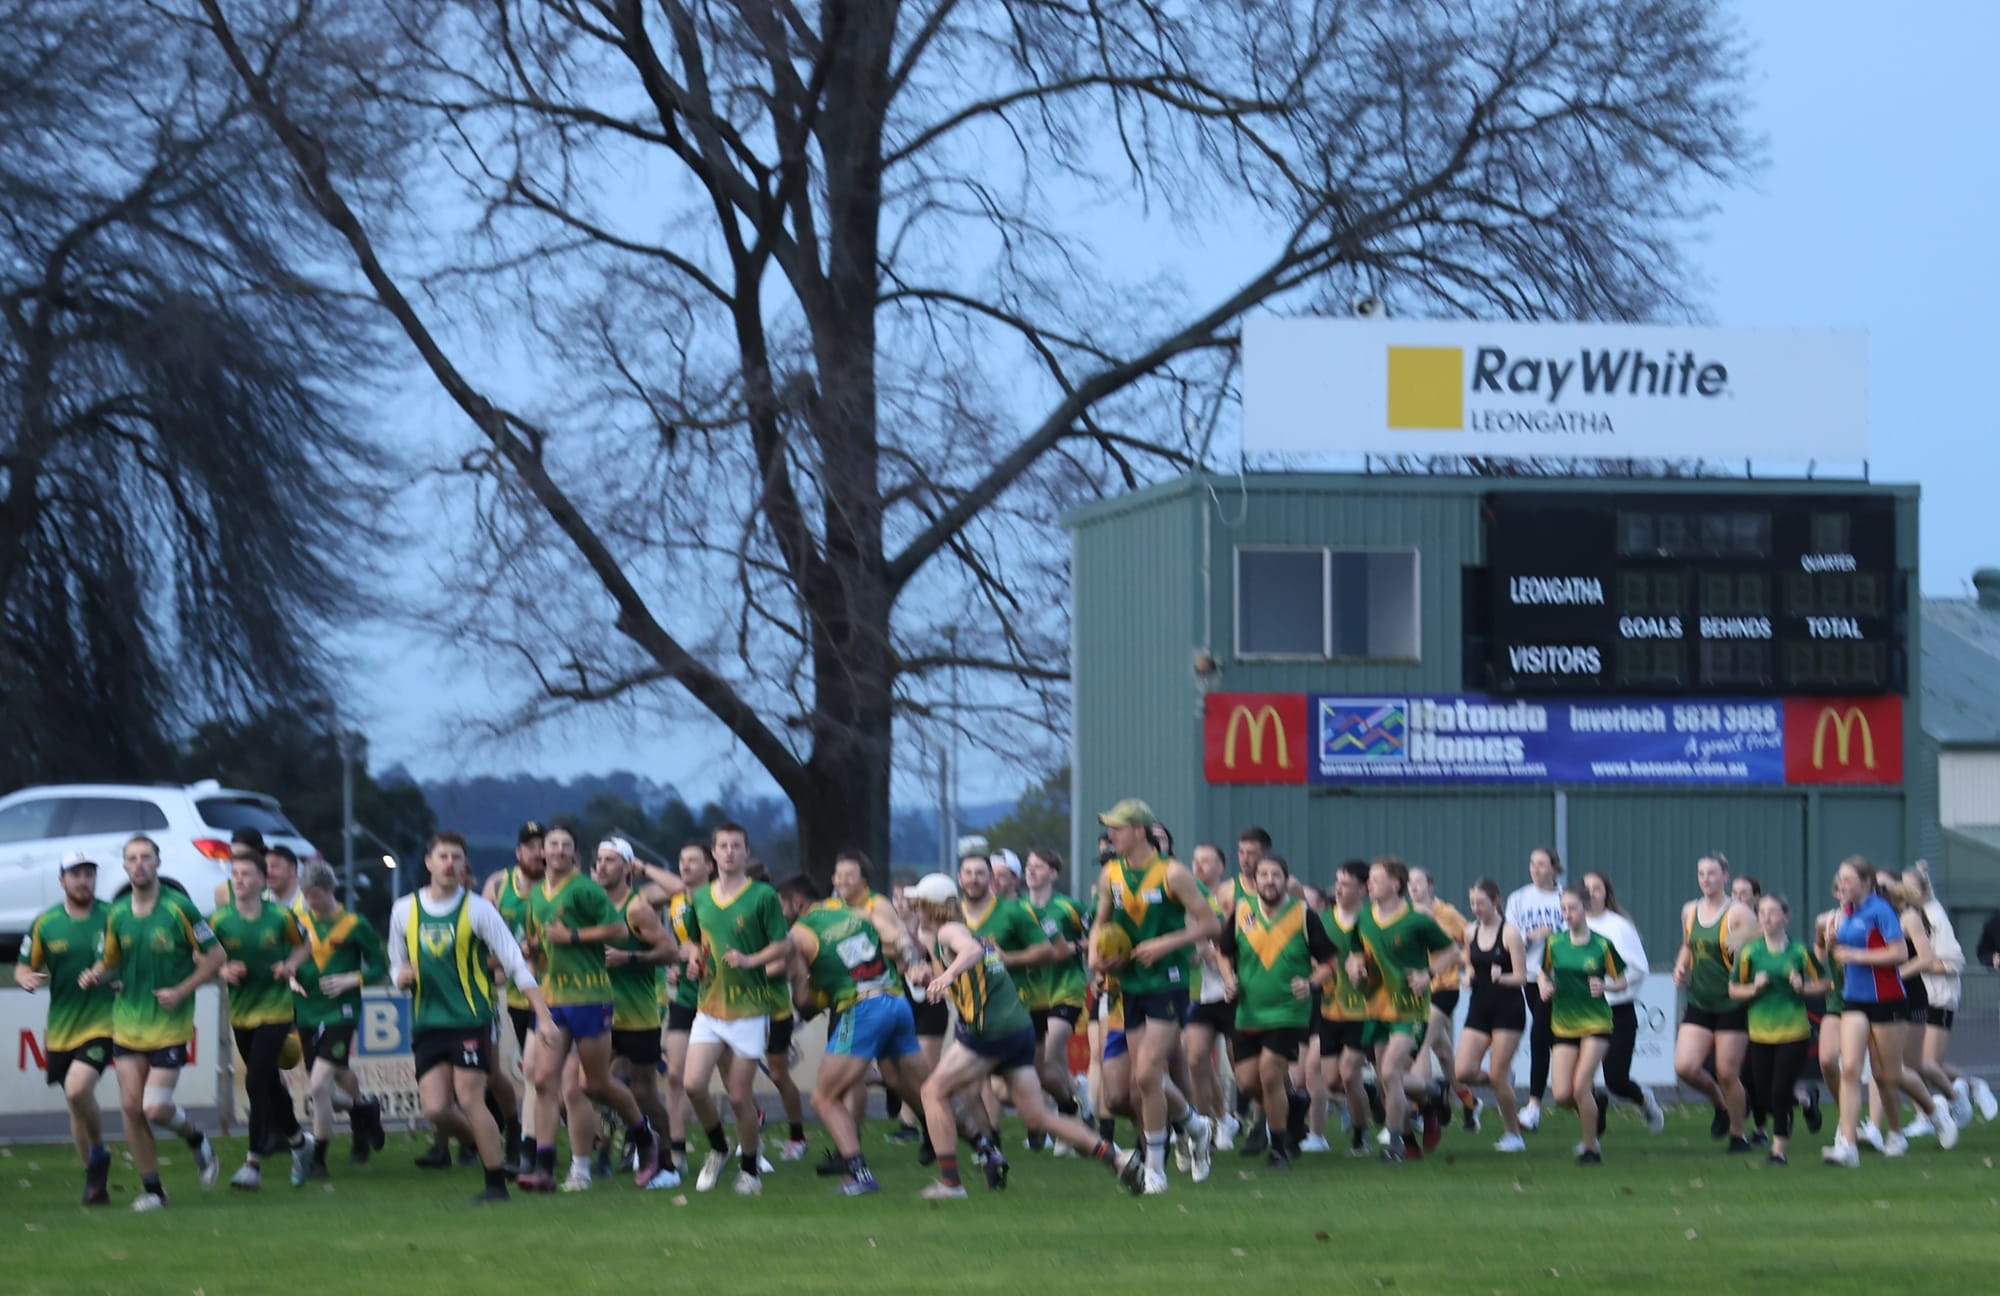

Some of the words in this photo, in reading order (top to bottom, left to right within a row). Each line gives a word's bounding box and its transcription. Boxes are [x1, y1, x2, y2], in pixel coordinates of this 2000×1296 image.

[1472, 346, 1575, 403] Ray
[1581, 347, 1728, 396] White
[1471, 409, 1615, 433] LEONGATHA
[1801, 554, 1857, 573] QUARTER
[1510, 575, 1605, 604] LEONGATHA
[1619, 616, 1683, 638] GOALS
[1700, 616, 1773, 638] BEHINDS
[1806, 616, 1864, 638] TOTAL
[1509, 645, 1601, 673] VISITORS
[1569, 705, 1667, 732] Inverloch
[1410, 733, 1525, 762] Homes
[363, 1001, 402, 1051] B
